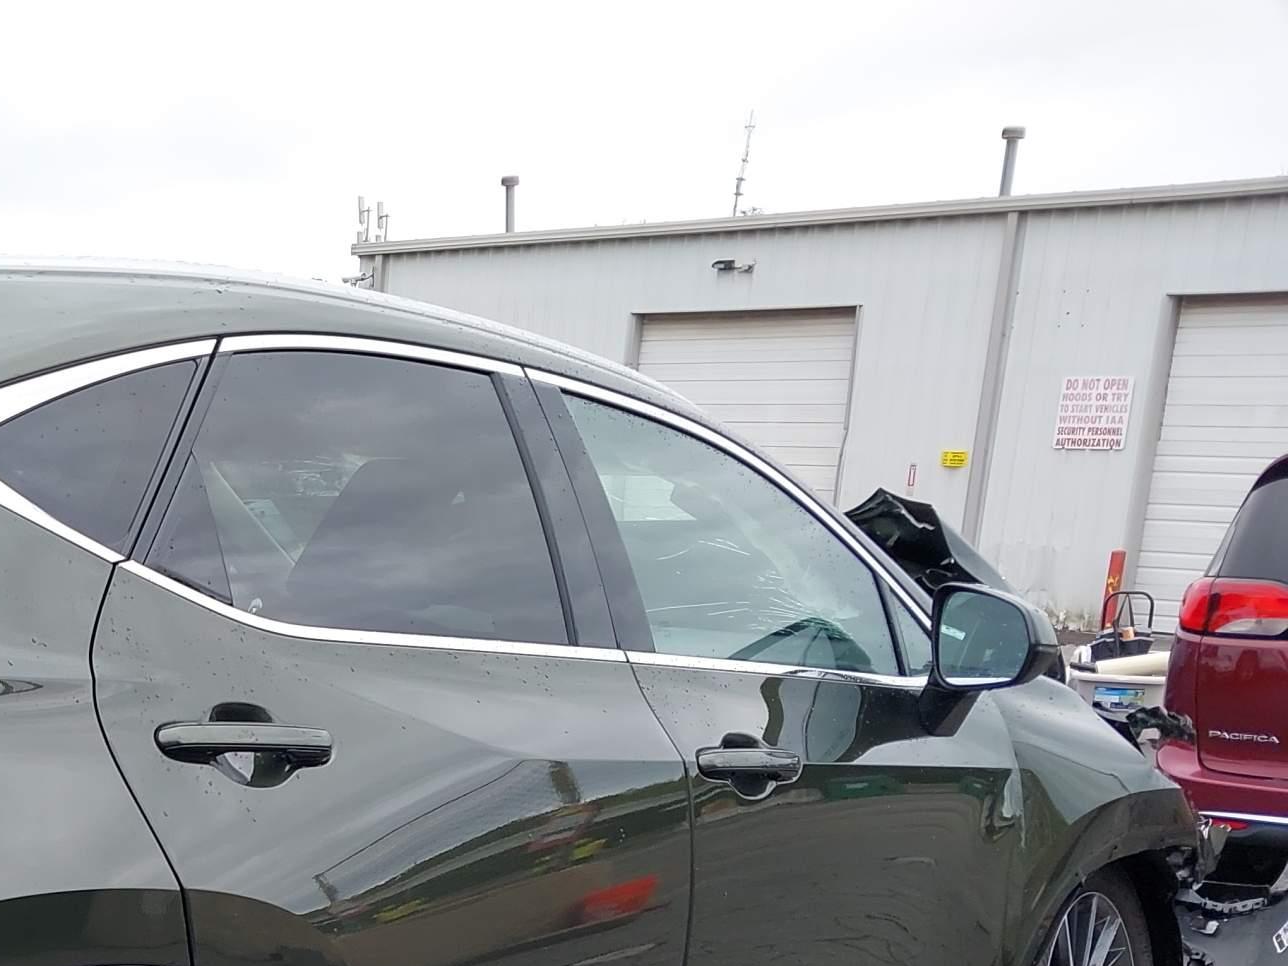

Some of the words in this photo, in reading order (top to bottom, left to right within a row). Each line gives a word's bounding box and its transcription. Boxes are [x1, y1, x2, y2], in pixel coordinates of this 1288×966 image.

[1065, 378, 1079, 391] DO
[1081, 378, 1101, 391] NOT
[1103, 378, 1129, 391] OPEN
[1062, 392, 1092, 402] HOODS
[1095, 392, 1108, 402] OR
[1111, 392, 1129, 402] TRY
[1060, 403, 1069, 413] TO
[1070, 403, 1092, 413] START
[1095, 403, 1128, 413] VEHICLES
[1059, 415, 1103, 425] WITHOUT
[1105, 415, 1124, 425] IAA
[1056, 426, 1086, 436] SECURITY
[1087, 426, 1123, 436] PERSONNEL
[1055, 438, 1122, 448] AUTHORIZATION
[1208, 730, 1280, 744] PACIFICA
